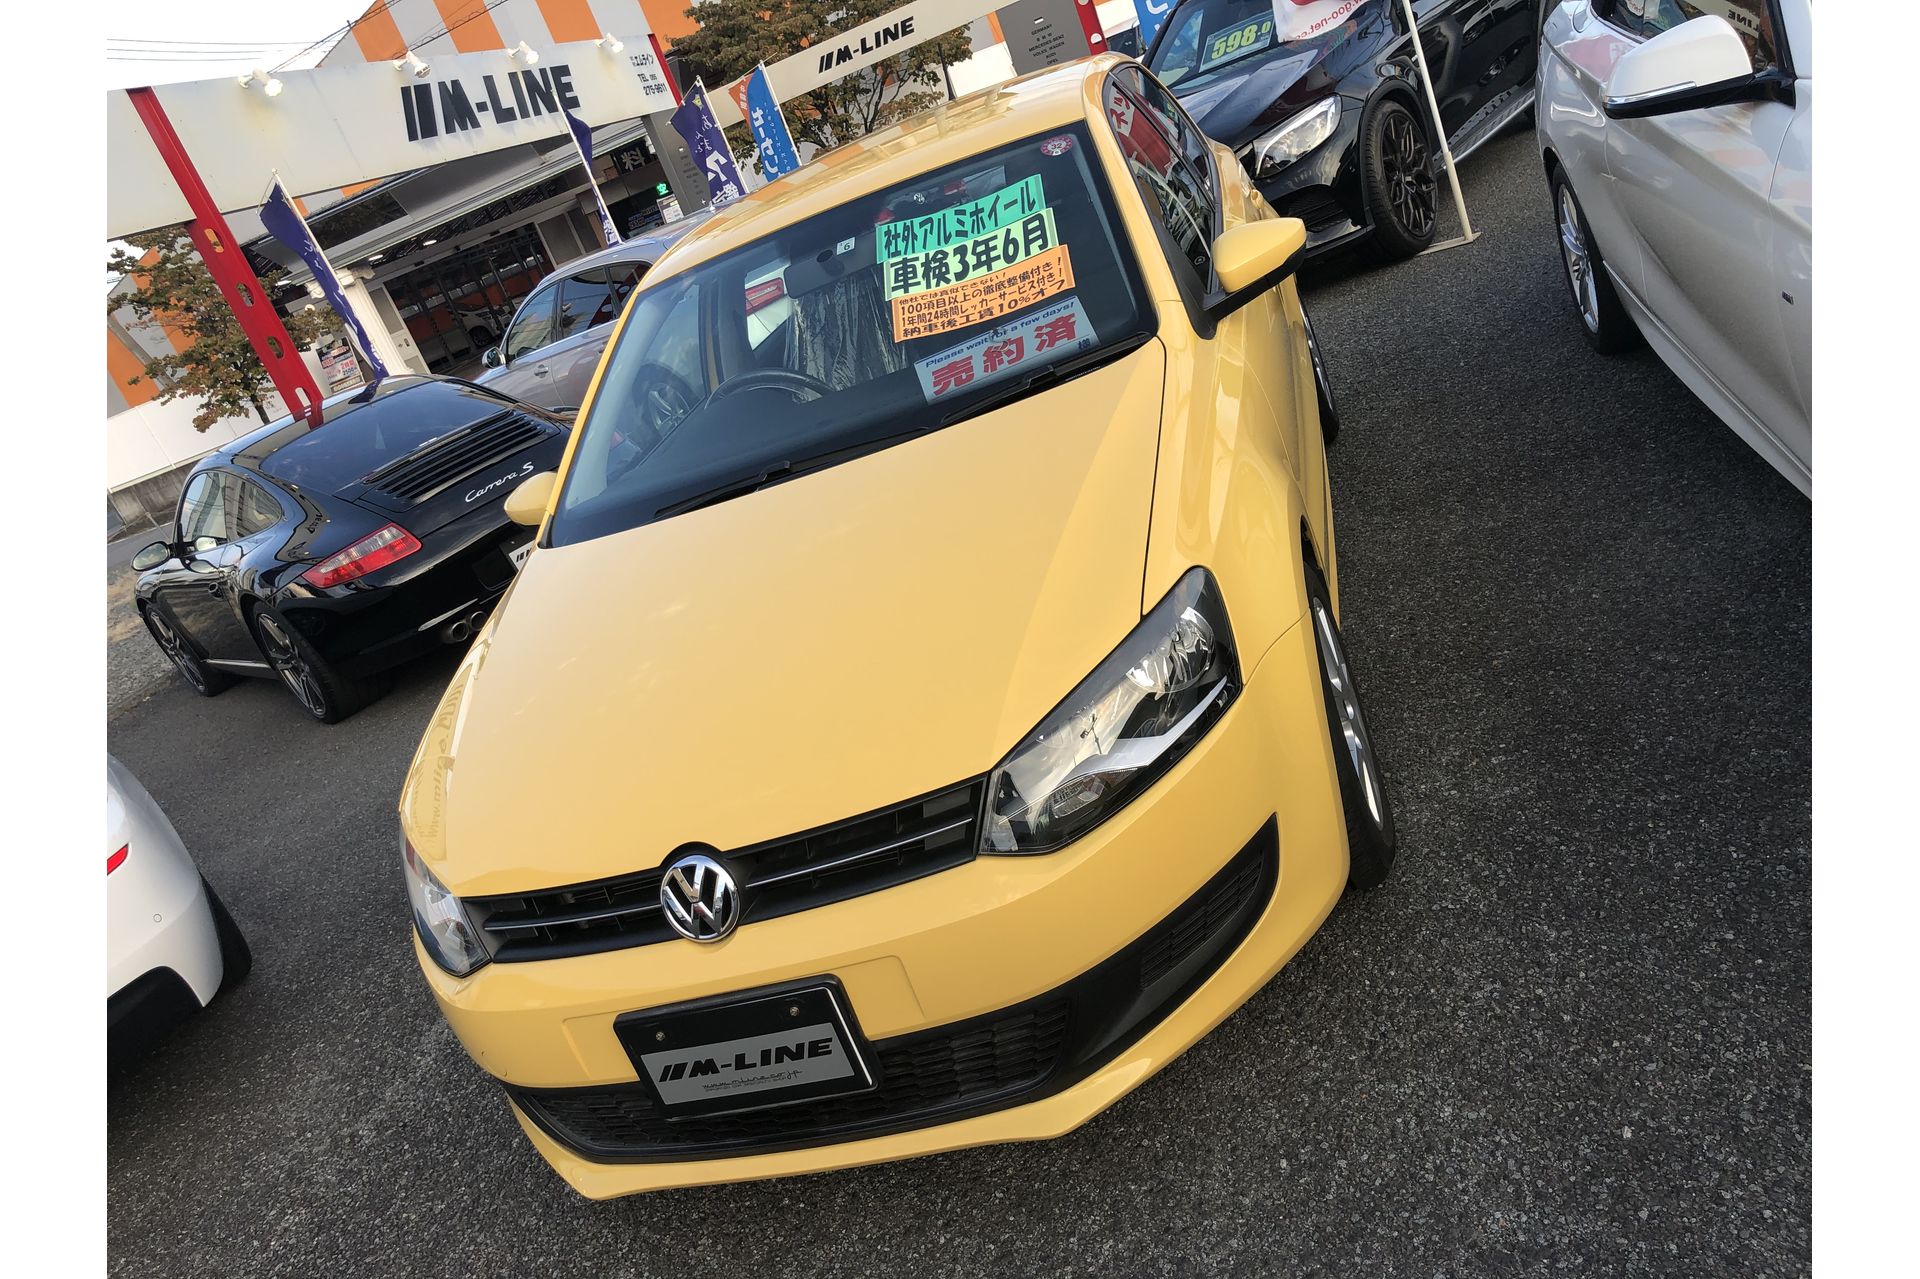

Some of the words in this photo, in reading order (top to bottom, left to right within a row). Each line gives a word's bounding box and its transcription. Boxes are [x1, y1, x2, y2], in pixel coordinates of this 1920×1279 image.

[637, 73, 649, 82] TEL
[884, 181, 1036, 258] 社外アルミホイール
[890, 212, 1049, 294] 車検3年6月
[925, 346, 965, 368] Please
[966, 337, 990, 351] wait
[1021, 315, 1040, 328] few
[1042, 302, 1076, 319] days!
[932, 313, 1077, 395] 売約済
[465, 471, 519, 503] Carrera
[519, 461, 535, 477] S
